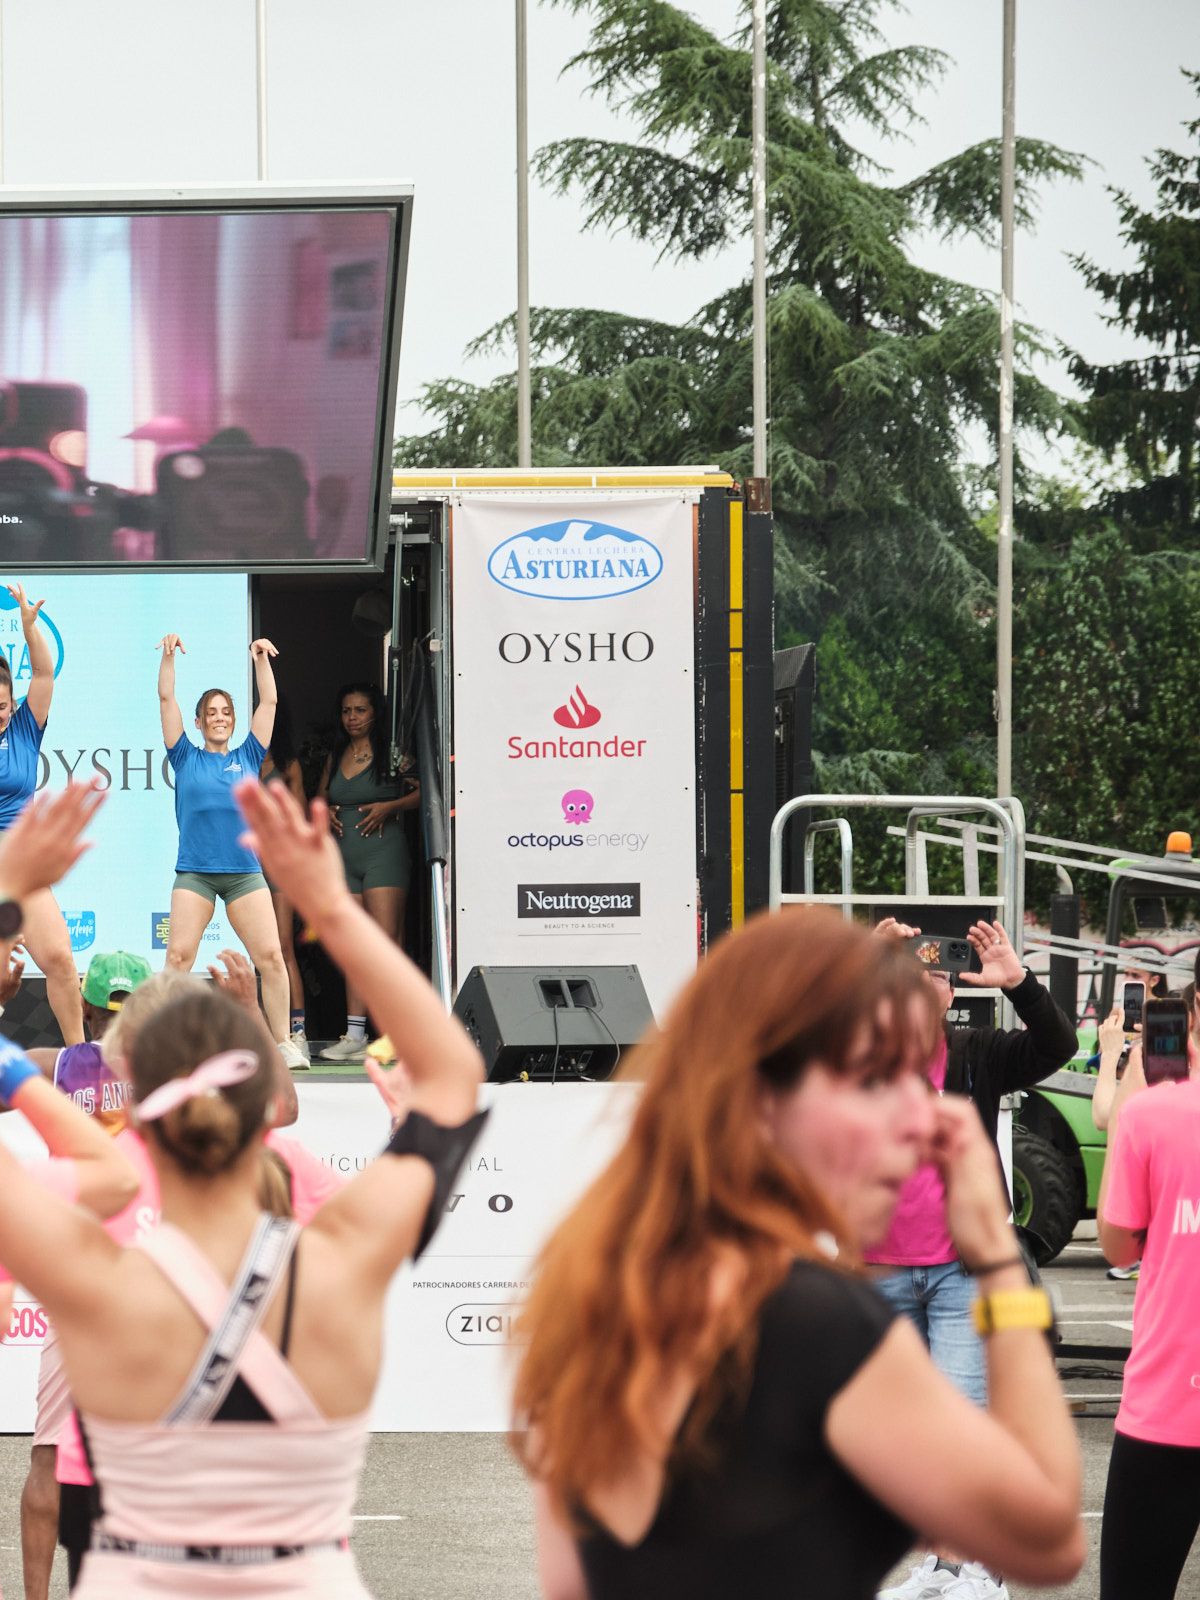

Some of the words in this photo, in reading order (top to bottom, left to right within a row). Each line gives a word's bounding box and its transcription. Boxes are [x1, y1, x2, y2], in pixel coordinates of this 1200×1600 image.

[527, 547, 583, 556] CENTRAL
[589, 545, 645, 555] LECHERA
[501, 550, 650, 580] ASTURIANA
[498, 630, 654, 664] OYSHO
[508, 735, 647, 759] Santander
[507, 832, 583, 851] octopus
[586, 832, 650, 852] energy
[525, 890, 633, 914] Neutrogena
